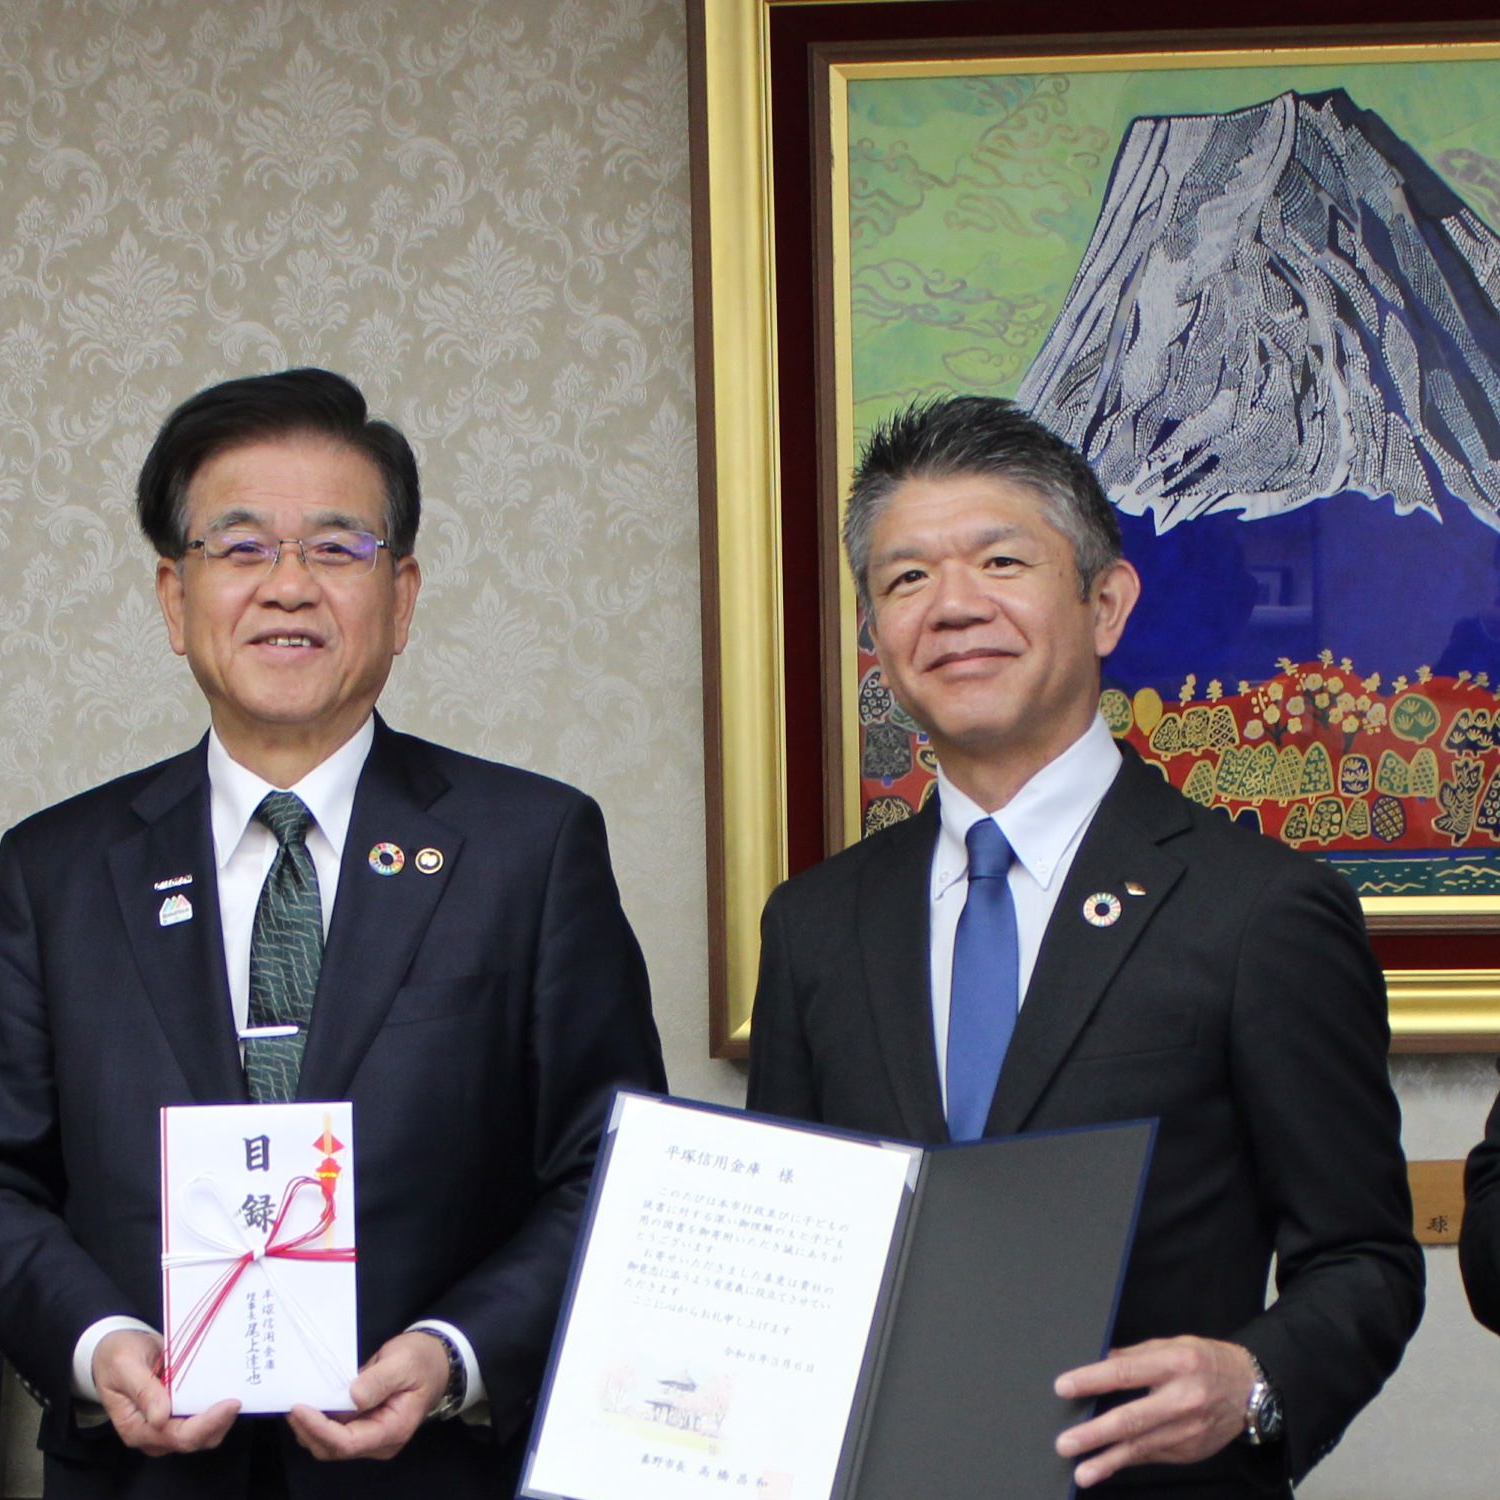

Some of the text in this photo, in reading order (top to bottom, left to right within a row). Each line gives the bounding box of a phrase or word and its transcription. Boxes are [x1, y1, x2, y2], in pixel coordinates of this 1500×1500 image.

[242, 1135, 276, 1233] 目録
[666, 1144, 795, 1185] 平塚信用金庫 様
